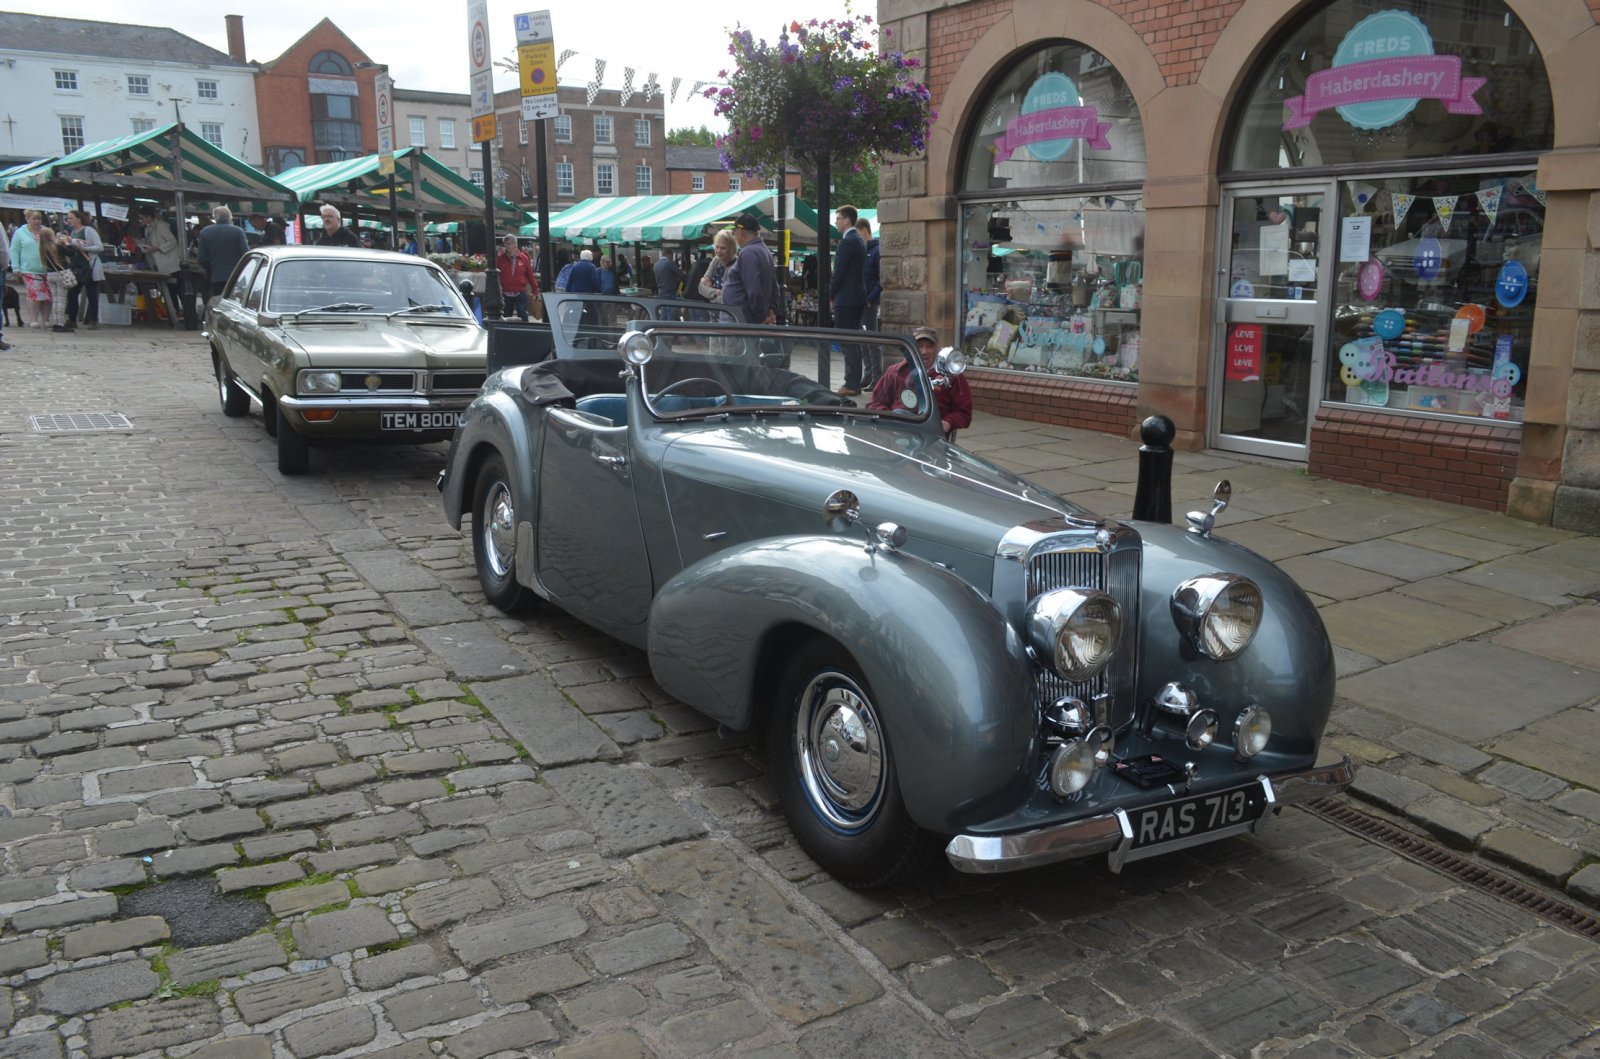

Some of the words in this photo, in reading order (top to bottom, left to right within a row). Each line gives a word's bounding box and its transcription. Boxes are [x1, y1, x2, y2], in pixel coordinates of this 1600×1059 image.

[521, 45, 551, 54] Restricted
[1353, 36, 1411, 57] FREDS
[1320, 67, 1445, 97] Haberdashery
[534, 96, 555, 104] loading
[1032, 91, 1067, 107] FREDS
[1014, 116, 1088, 138] Haberdashery
[1235, 330, 1255, 338] LOVE
[1234, 344, 1254, 353] LOVE
[1233, 358, 1253, 367] LOVE
[1365, 351, 1493, 392] Buttons
[383, 413, 417, 428] TEM
[1139, 802, 1197, 844] RAS
[1205, 791, 1246, 828] 713
